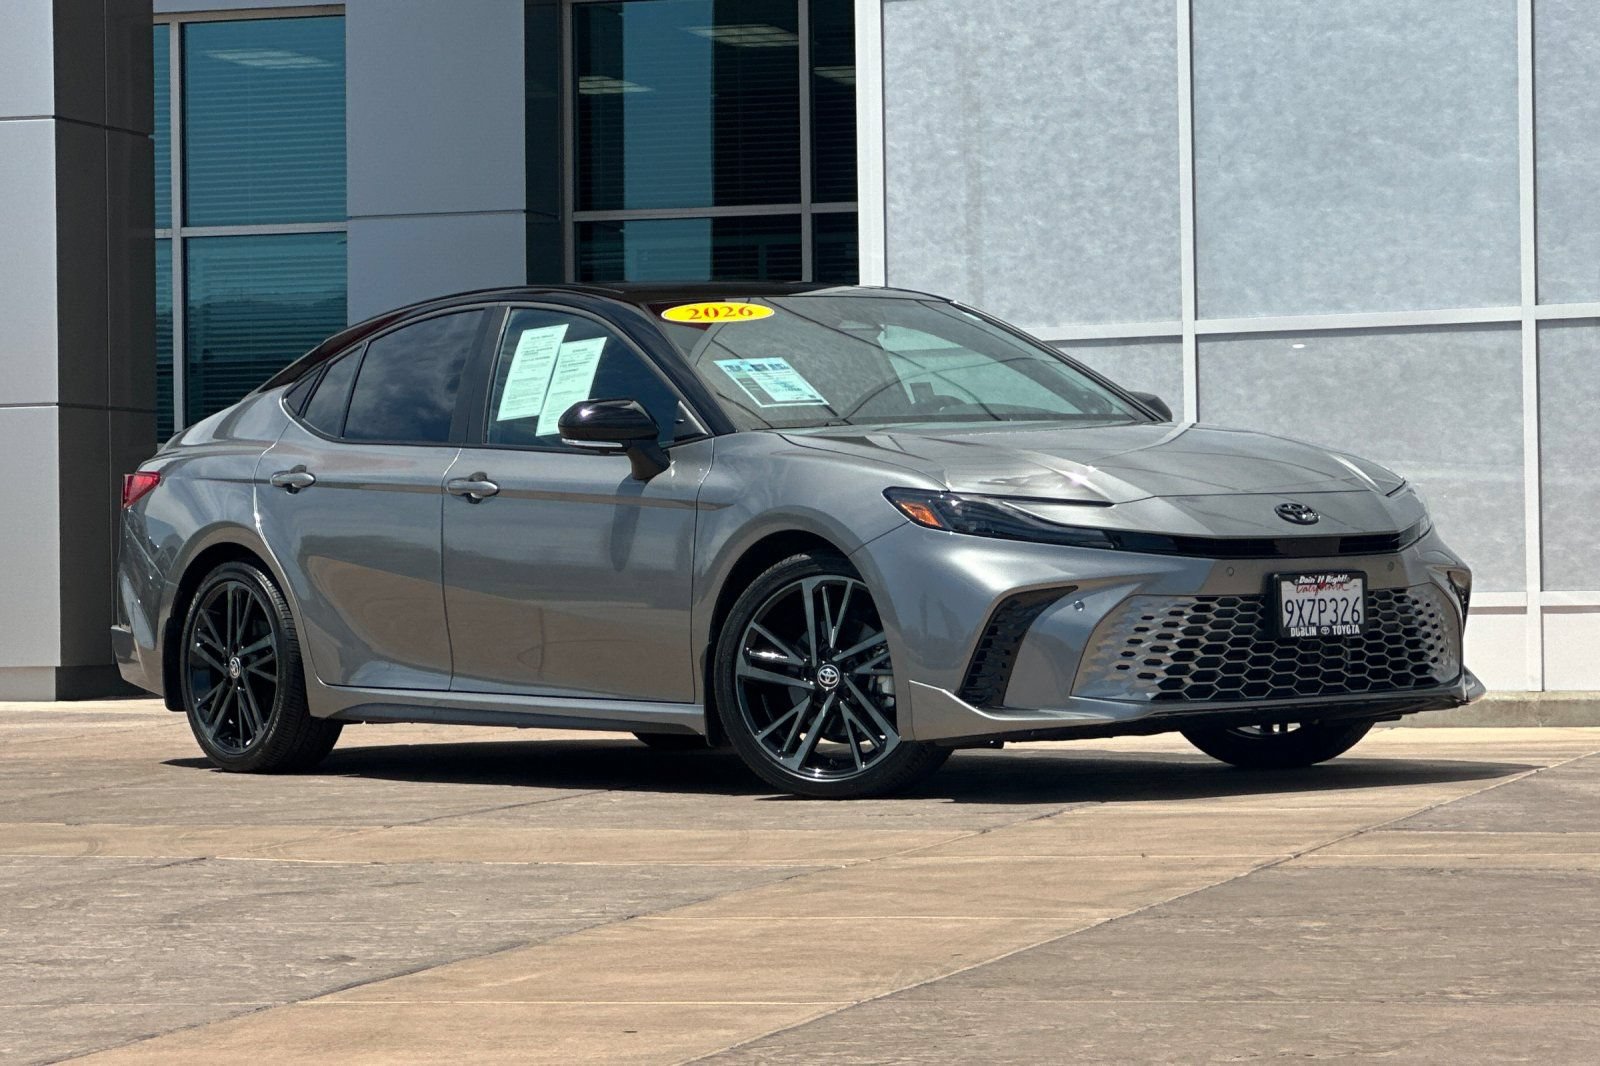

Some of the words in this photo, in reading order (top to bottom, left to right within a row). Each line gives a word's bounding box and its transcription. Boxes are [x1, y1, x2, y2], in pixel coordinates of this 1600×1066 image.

[687, 306, 753, 319] 2026
[1285, 597, 1360, 627] 9XZP326
[1291, 626, 1317, 637] DUBLIN
[1332, 625, 1360, 636] TOYOTA
